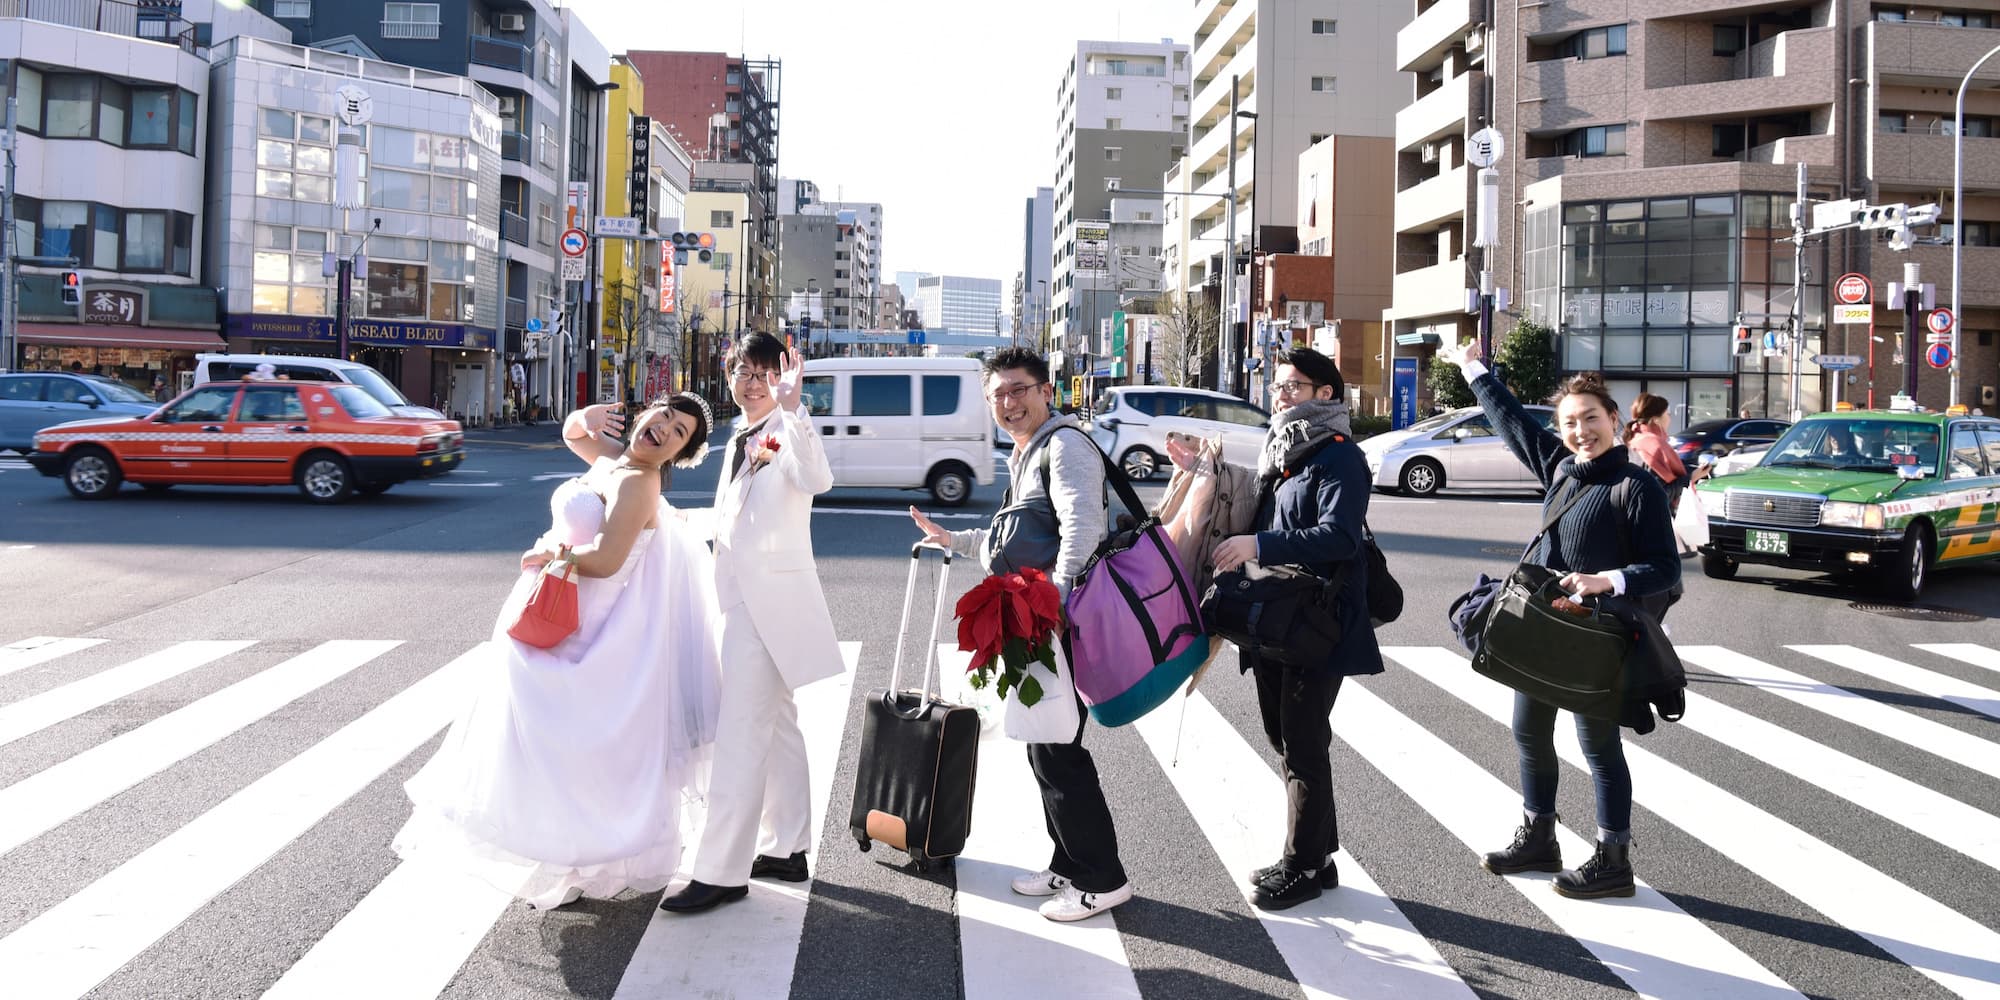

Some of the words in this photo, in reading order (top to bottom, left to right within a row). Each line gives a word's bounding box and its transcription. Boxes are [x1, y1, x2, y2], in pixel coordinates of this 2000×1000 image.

[599, 218, 636, 229] 森下駅前
[91, 291, 135, 322] 茶月
[86, 313, 119, 322] KYOTO
[252, 323, 302, 333] PATISSERIE
[406, 326, 446, 342] BLEU
[1754, 538, 1787, 553] 63-75
